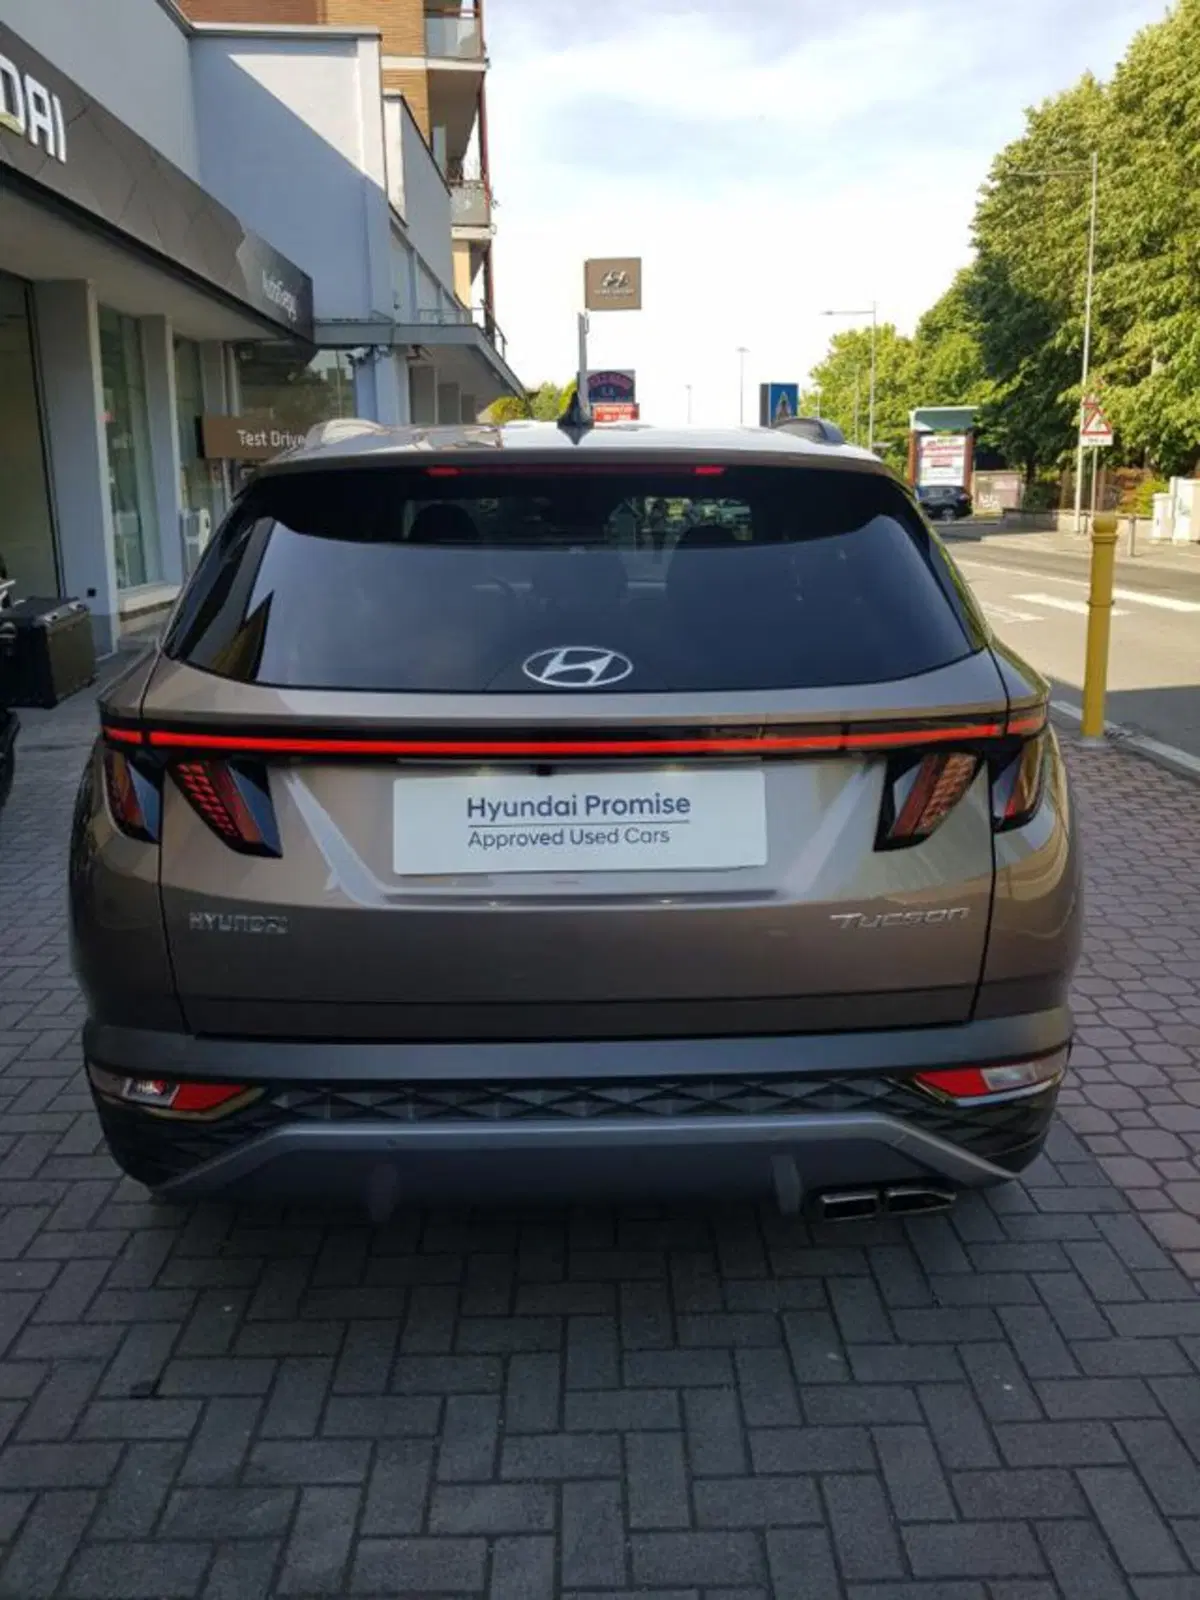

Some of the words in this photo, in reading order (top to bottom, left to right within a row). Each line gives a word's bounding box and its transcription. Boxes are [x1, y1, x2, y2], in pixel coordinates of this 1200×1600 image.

[236, 430, 266, 446] Test
[466, 795, 577, 822] Hyundai
[585, 793, 691, 816] Promise
[467, 829, 564, 850] Approved
[569, 828, 619, 846] Used
[624, 827, 670, 844] Cars
[189, 911, 288, 934] HYUNDAI
